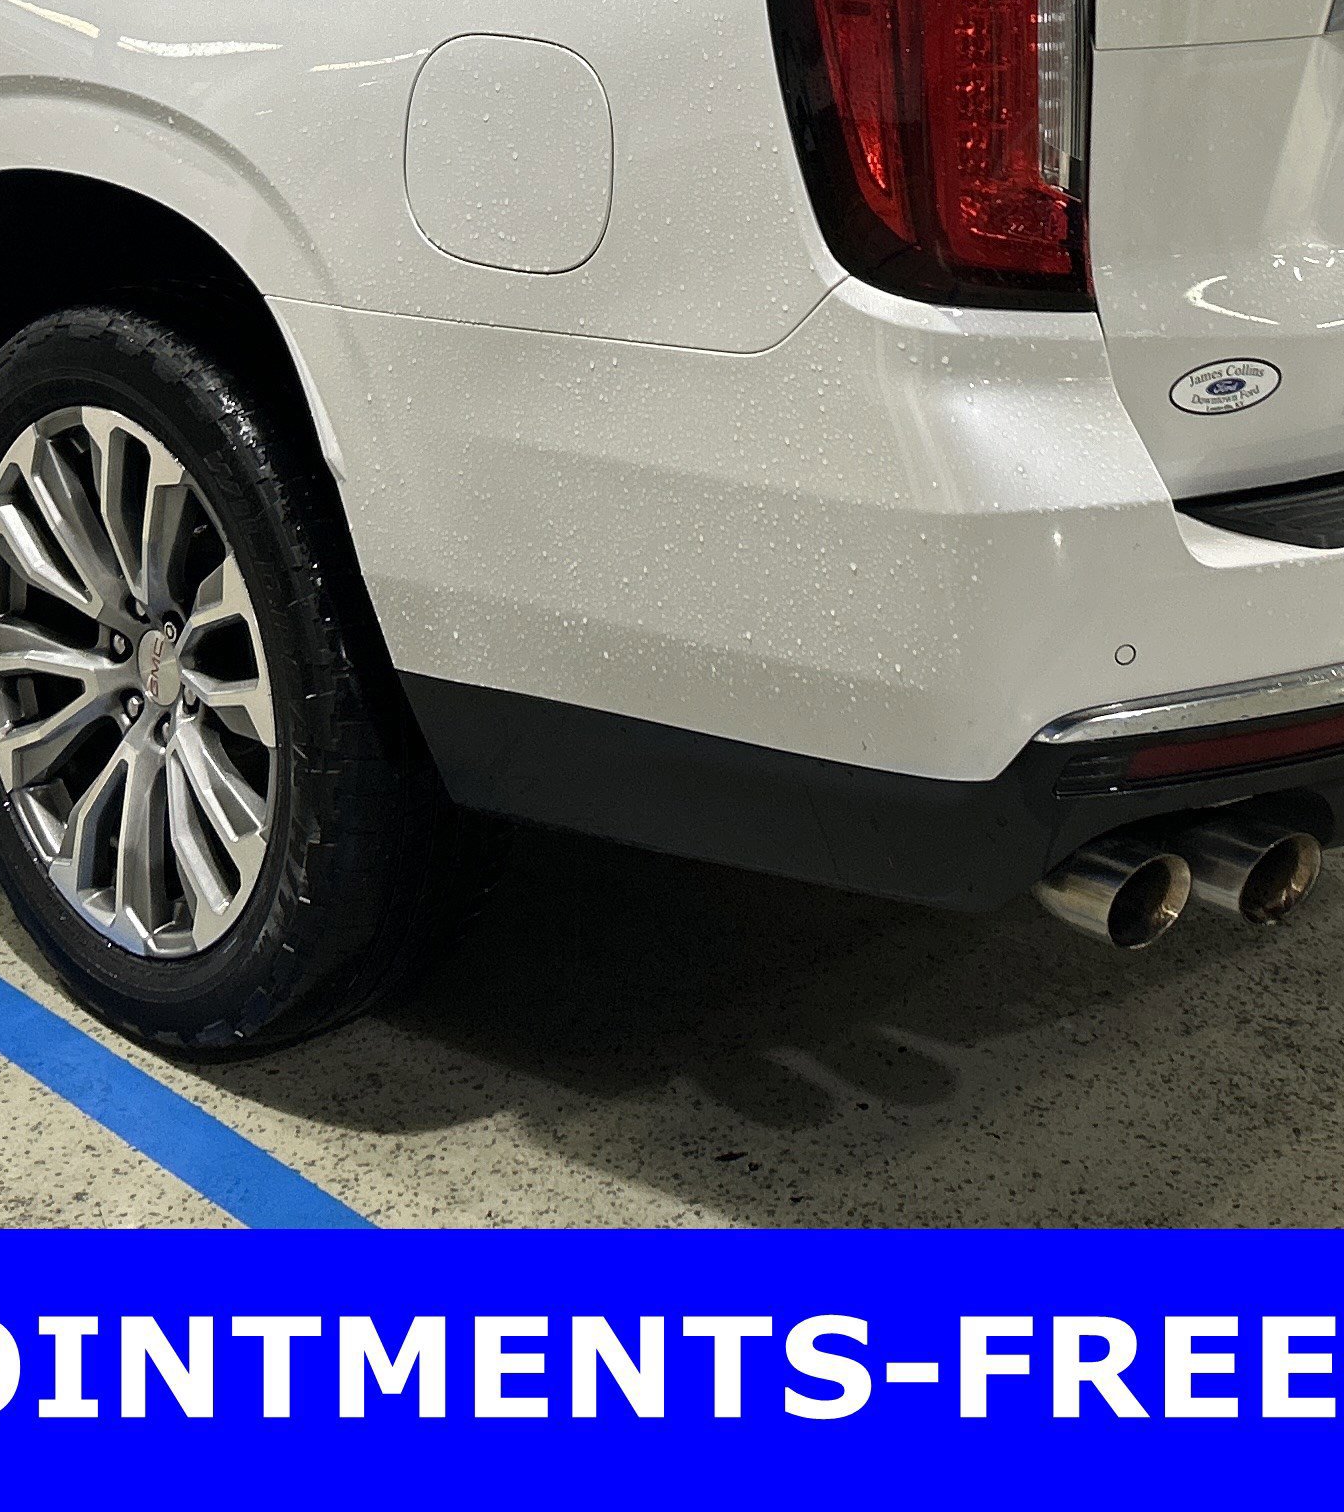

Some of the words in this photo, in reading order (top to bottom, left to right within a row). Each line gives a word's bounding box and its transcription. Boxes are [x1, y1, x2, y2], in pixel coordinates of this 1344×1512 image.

[1189, 368, 1223, 388] James
[1225, 364, 1265, 378] Collins
[150, 636, 165, 699] GMC
